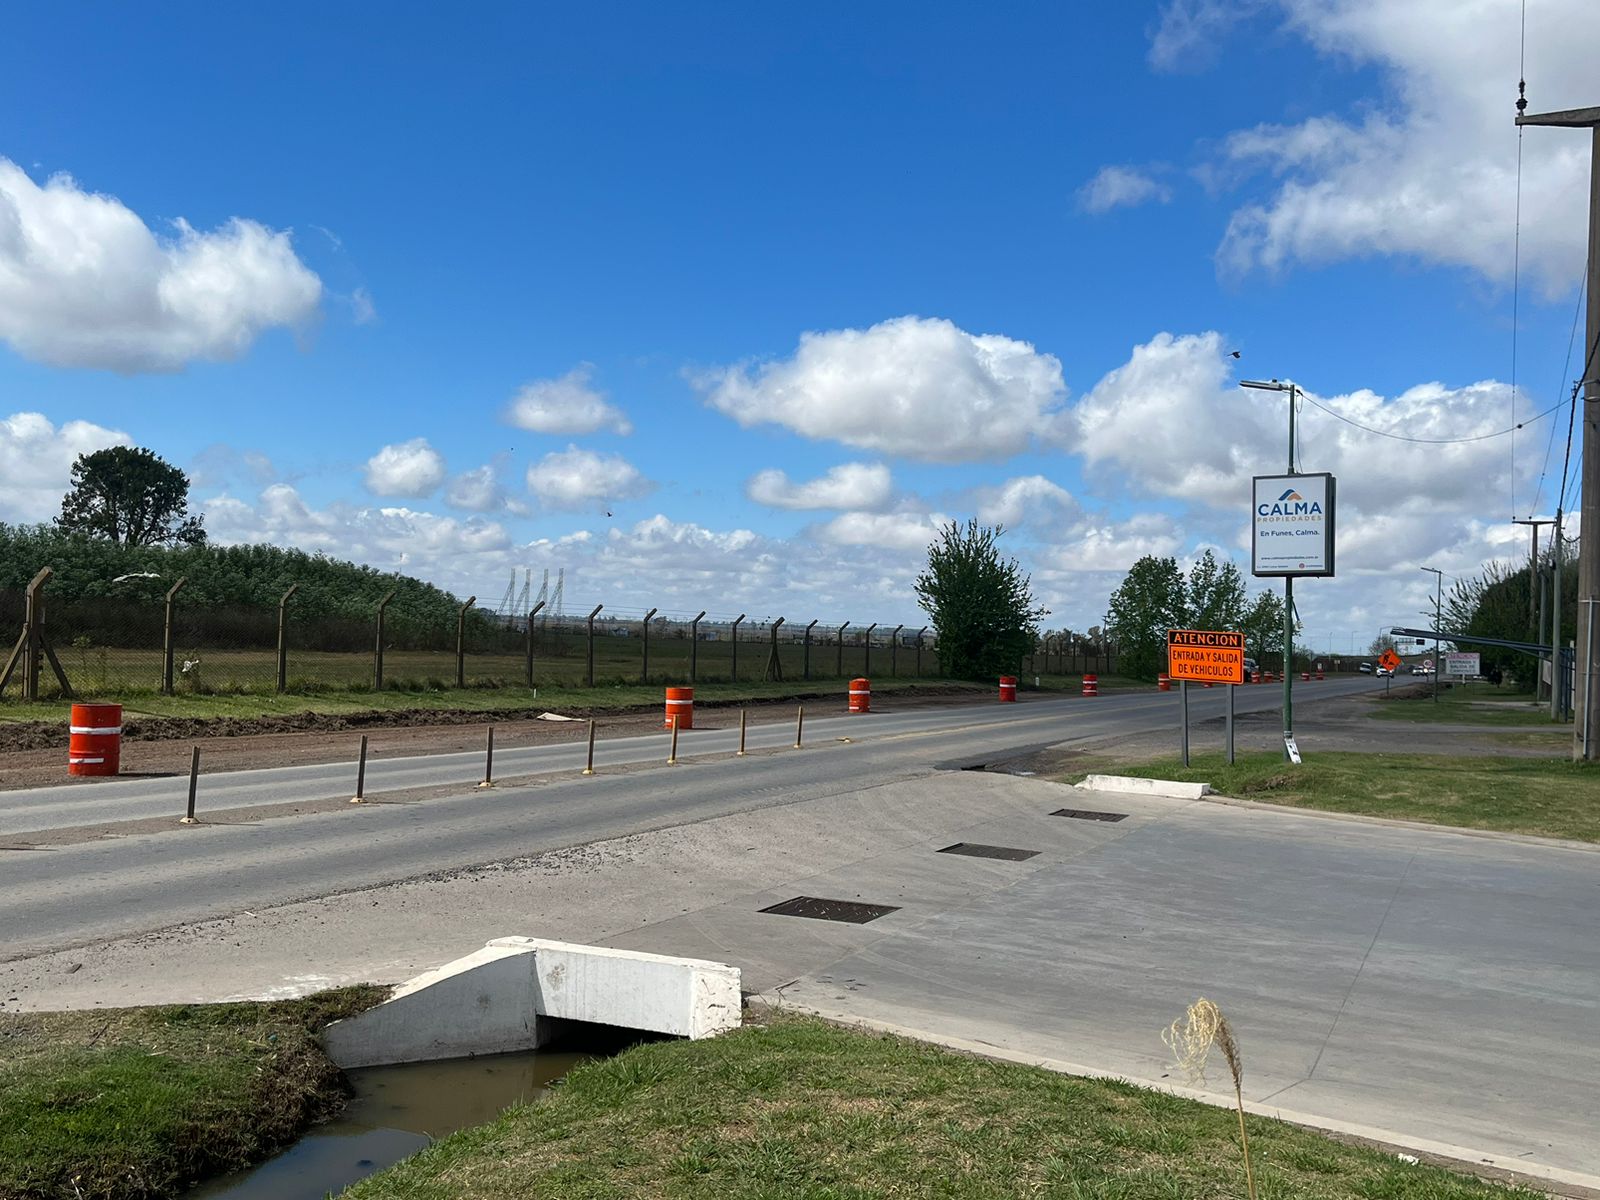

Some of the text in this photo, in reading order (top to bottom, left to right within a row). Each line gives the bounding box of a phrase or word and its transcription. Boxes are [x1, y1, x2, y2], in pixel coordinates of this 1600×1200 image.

[1258, 502, 1322, 516] CALMA
[1257, 515, 1322, 523] PROPIEDADES
[1174, 633, 1238, 645] ATENCION
[1172, 650, 1239, 664] ENTRADA Y SALIDA
[1178, 663, 1233, 677] DE VEHICULOS
